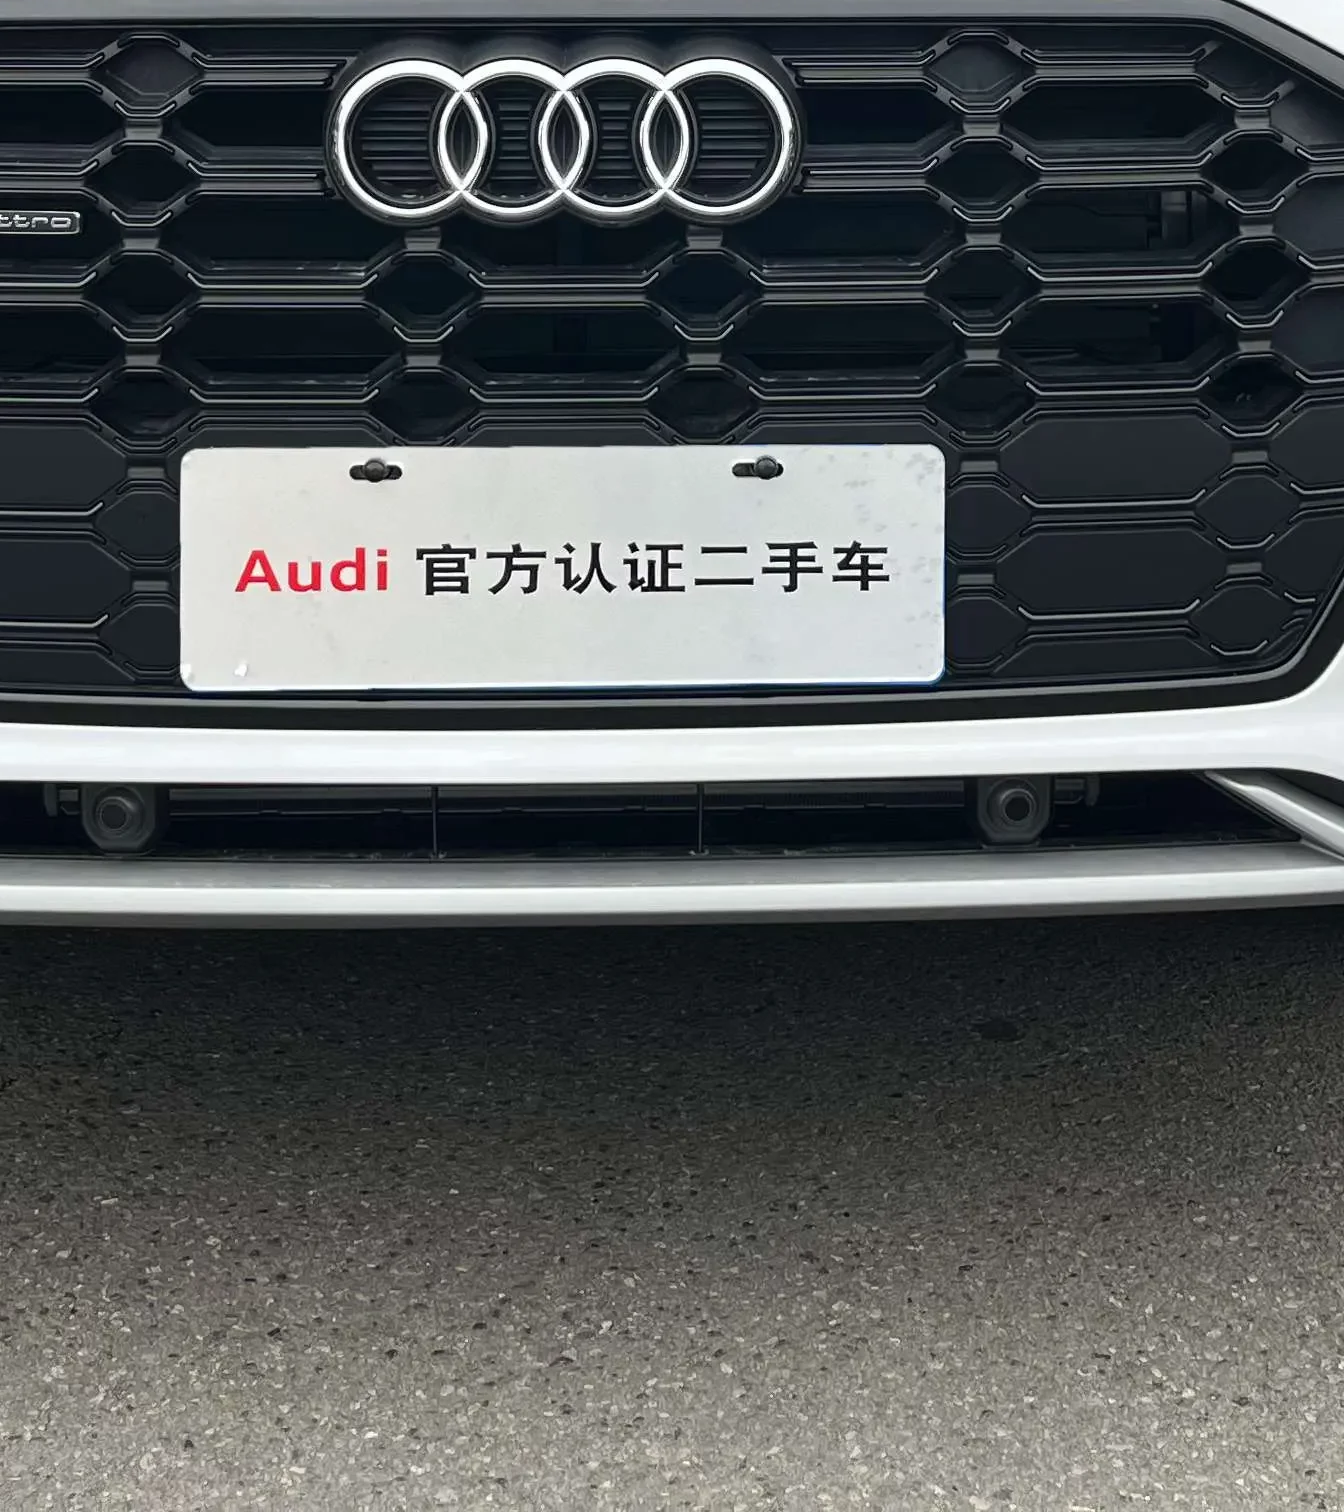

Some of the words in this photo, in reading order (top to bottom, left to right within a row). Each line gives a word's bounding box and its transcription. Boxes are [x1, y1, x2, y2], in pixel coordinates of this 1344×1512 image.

[235, 547, 390, 594] Audi
[415, 540, 891, 597] 官方认证二手车
